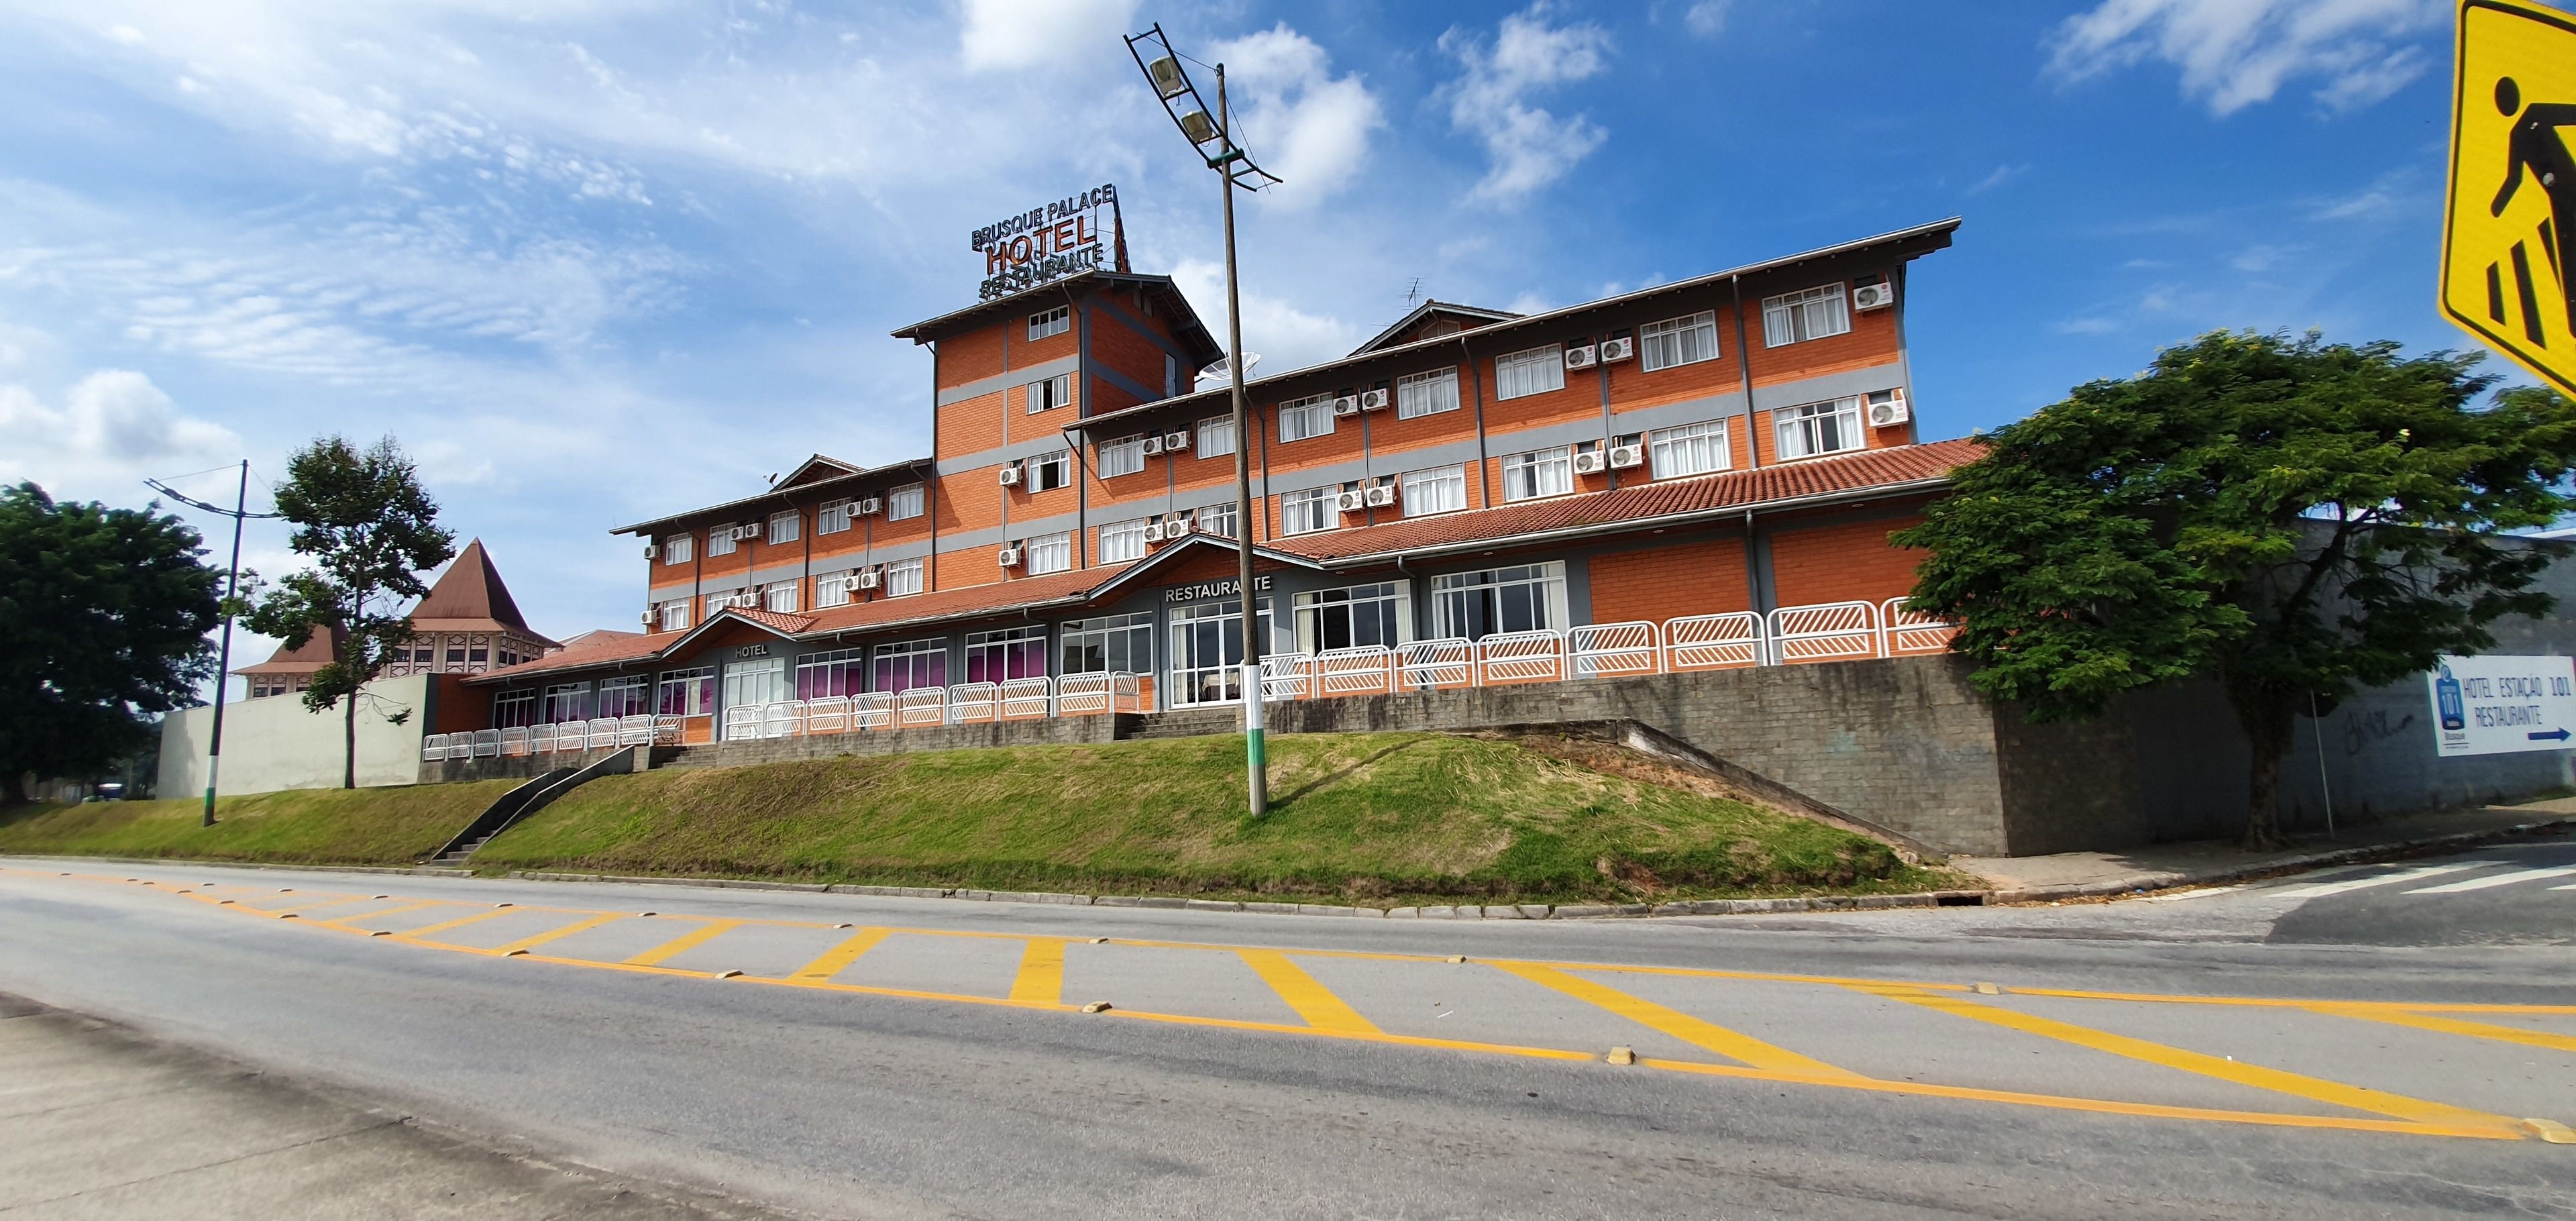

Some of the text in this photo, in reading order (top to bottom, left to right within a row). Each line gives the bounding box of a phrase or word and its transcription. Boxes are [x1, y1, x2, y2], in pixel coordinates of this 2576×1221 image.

[972, 183, 1112, 251] BRUSQUE PALACE
[987, 215, 1097, 275] HOTEL
[980, 243, 1104, 299] RESTAURANTE
[1165, 576, 1271, 602] RESTAURATE
[735, 644, 767, 658] HOTEL
[2462, 674, 2571, 699] HOTEL ESTAÇÃO 101
[2442, 693, 2460, 714] 101
[2474, 705, 2542, 727] RESTAURANTE
